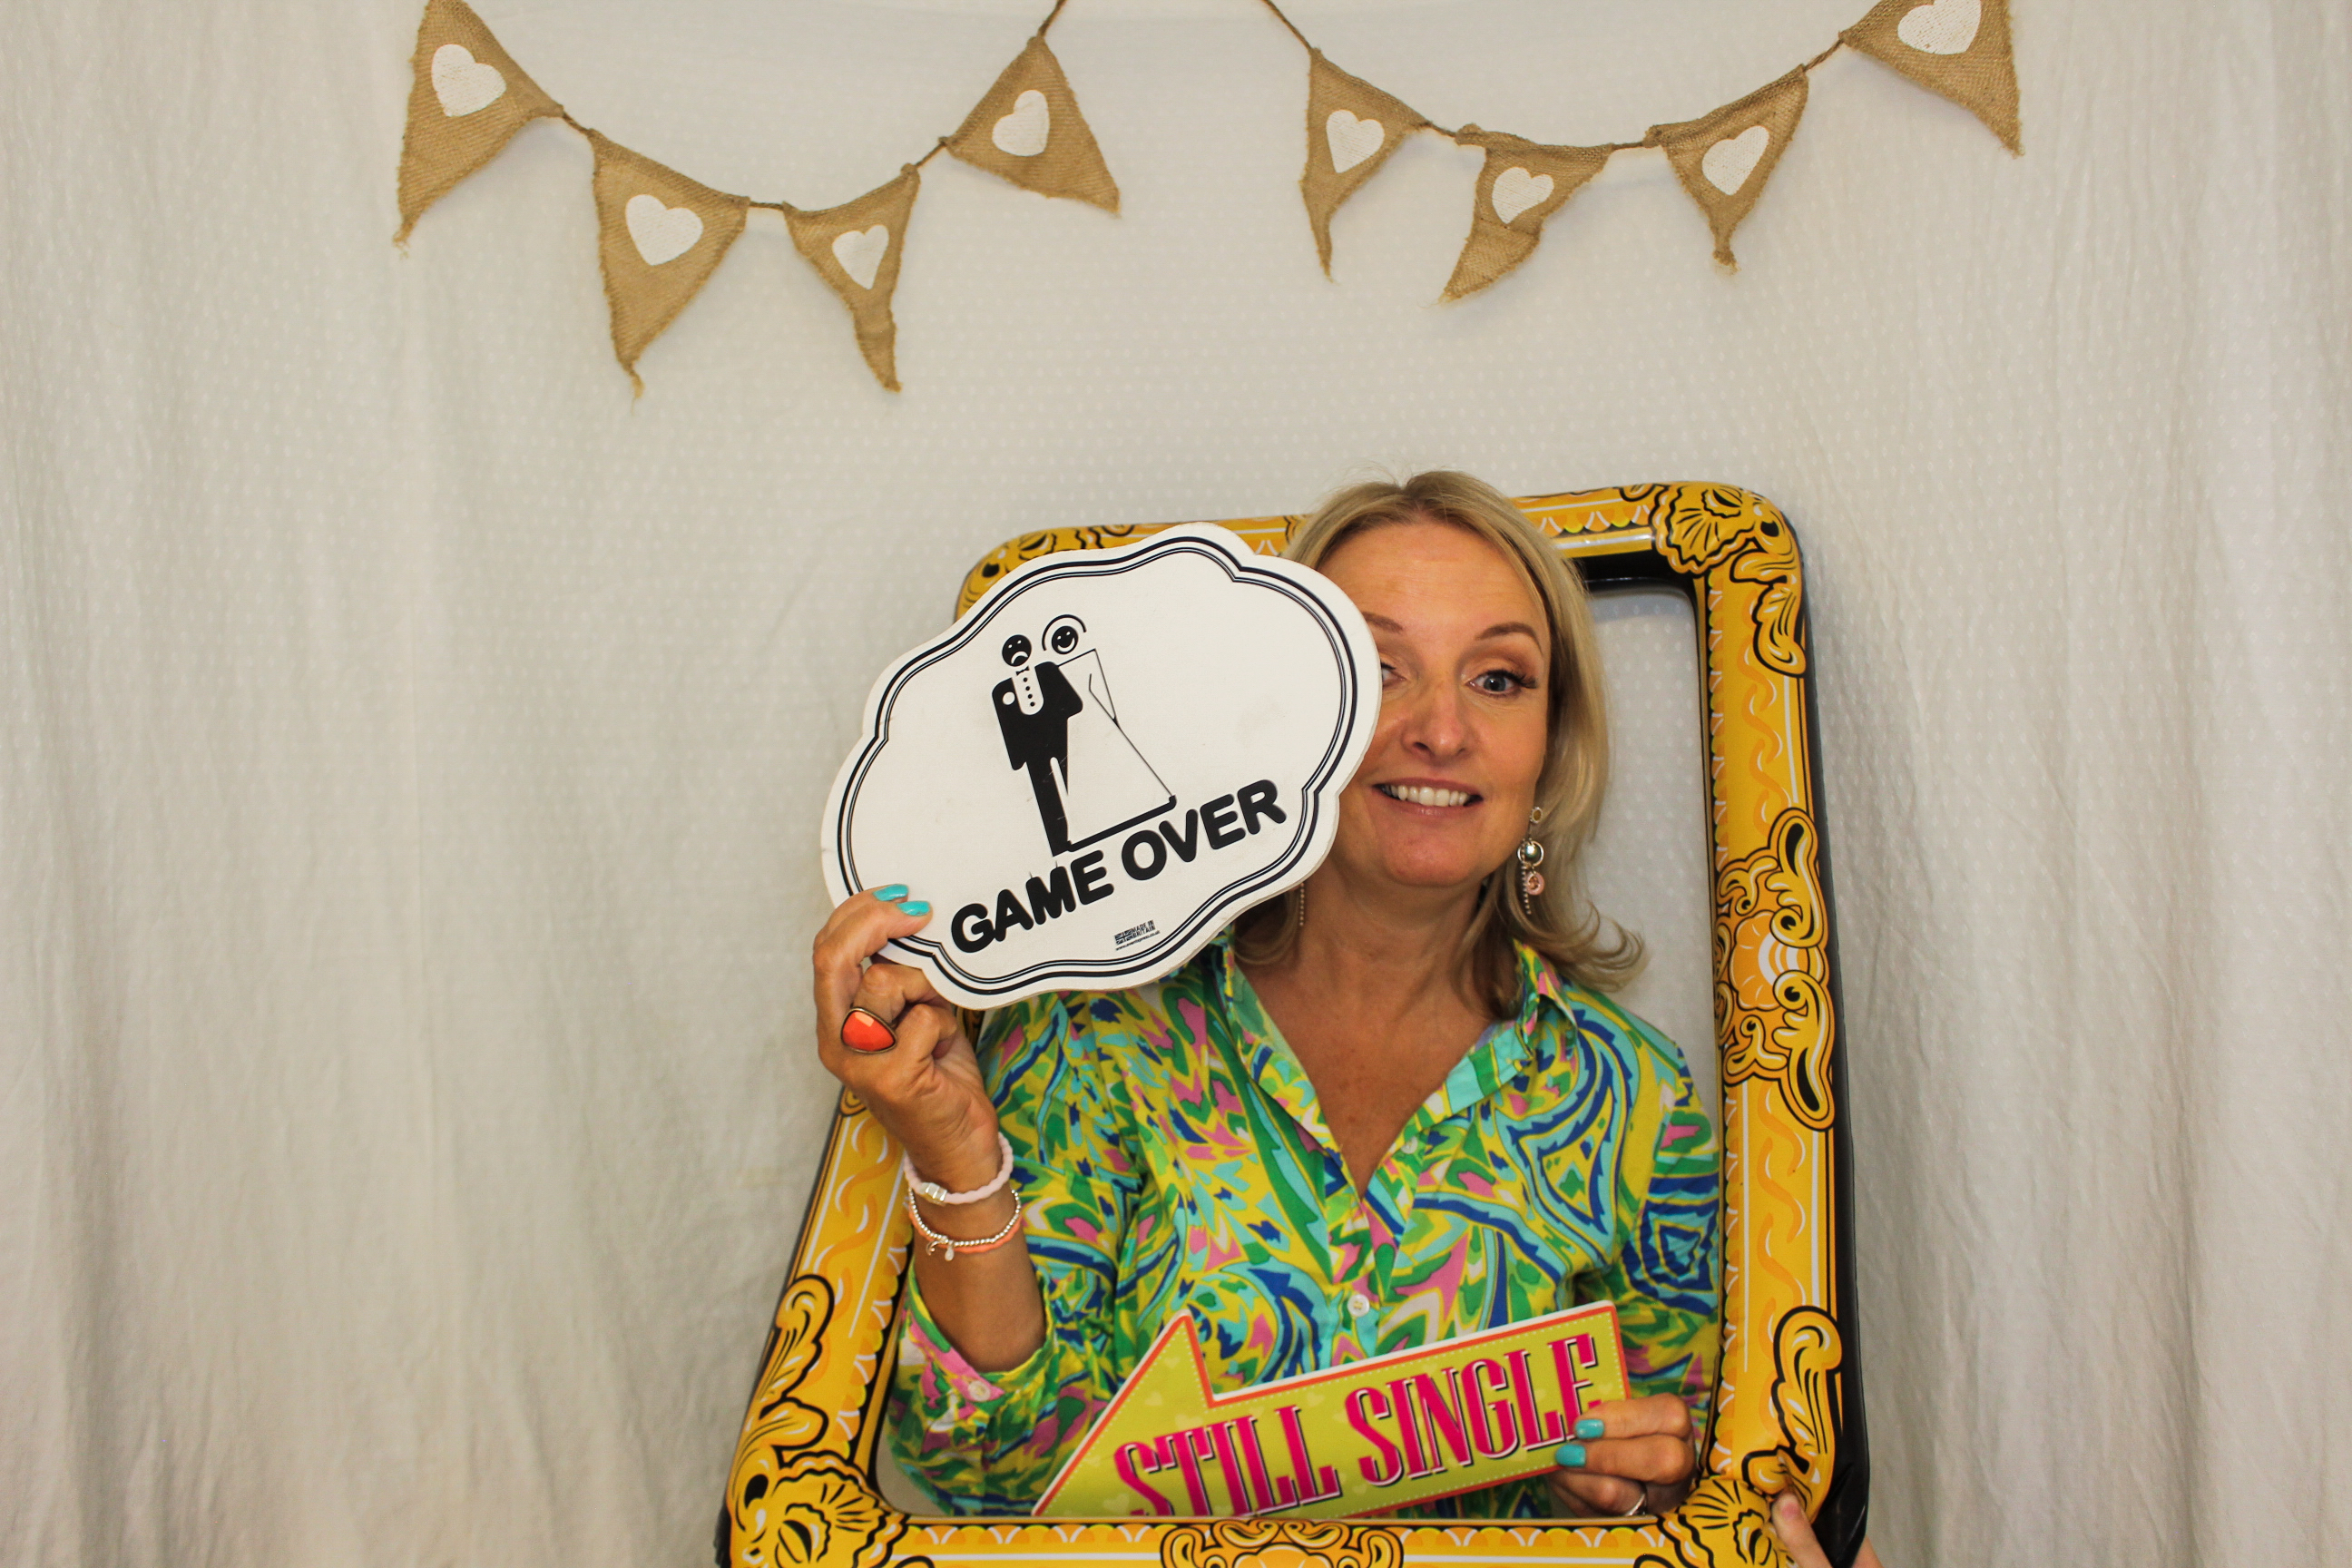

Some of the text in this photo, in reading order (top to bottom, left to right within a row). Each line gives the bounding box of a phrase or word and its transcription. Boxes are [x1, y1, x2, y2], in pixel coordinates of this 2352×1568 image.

[951, 779, 1287, 953] GAME OVER
[1132, 922, 1146, 933] MADE
[1132, 926, 1156, 938] BRITAIN
[1113, 1333, 1602, 1516] STILL SINGLE
